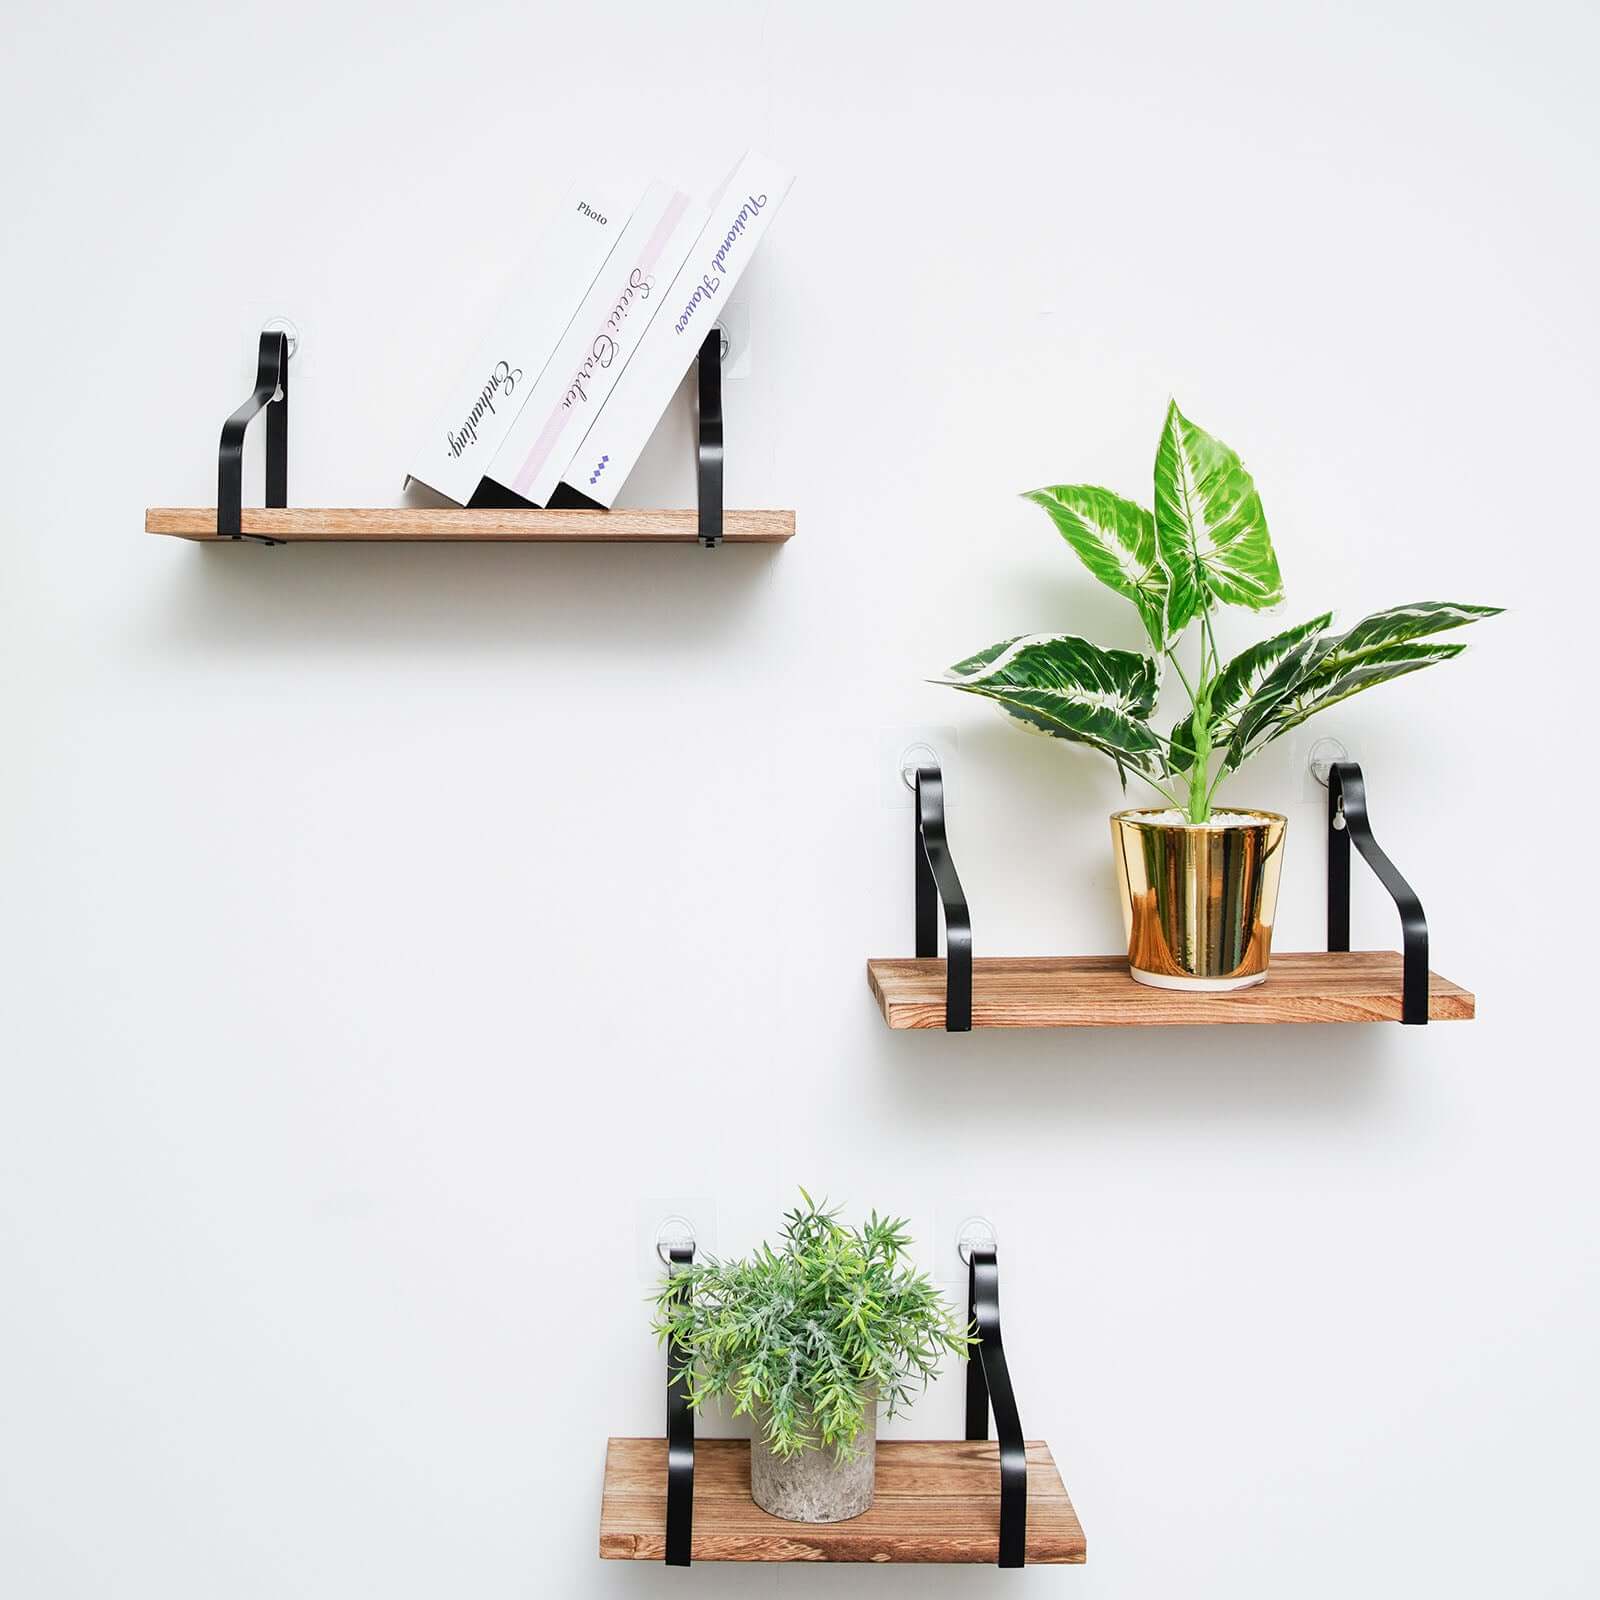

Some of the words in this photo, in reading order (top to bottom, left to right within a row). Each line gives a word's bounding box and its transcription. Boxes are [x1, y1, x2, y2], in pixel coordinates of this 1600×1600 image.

[577, 200, 608, 227] Photo
[711, 194, 768, 273] National
[674, 275, 721, 336] Flower
[559, 335, 621, 410] Garden
